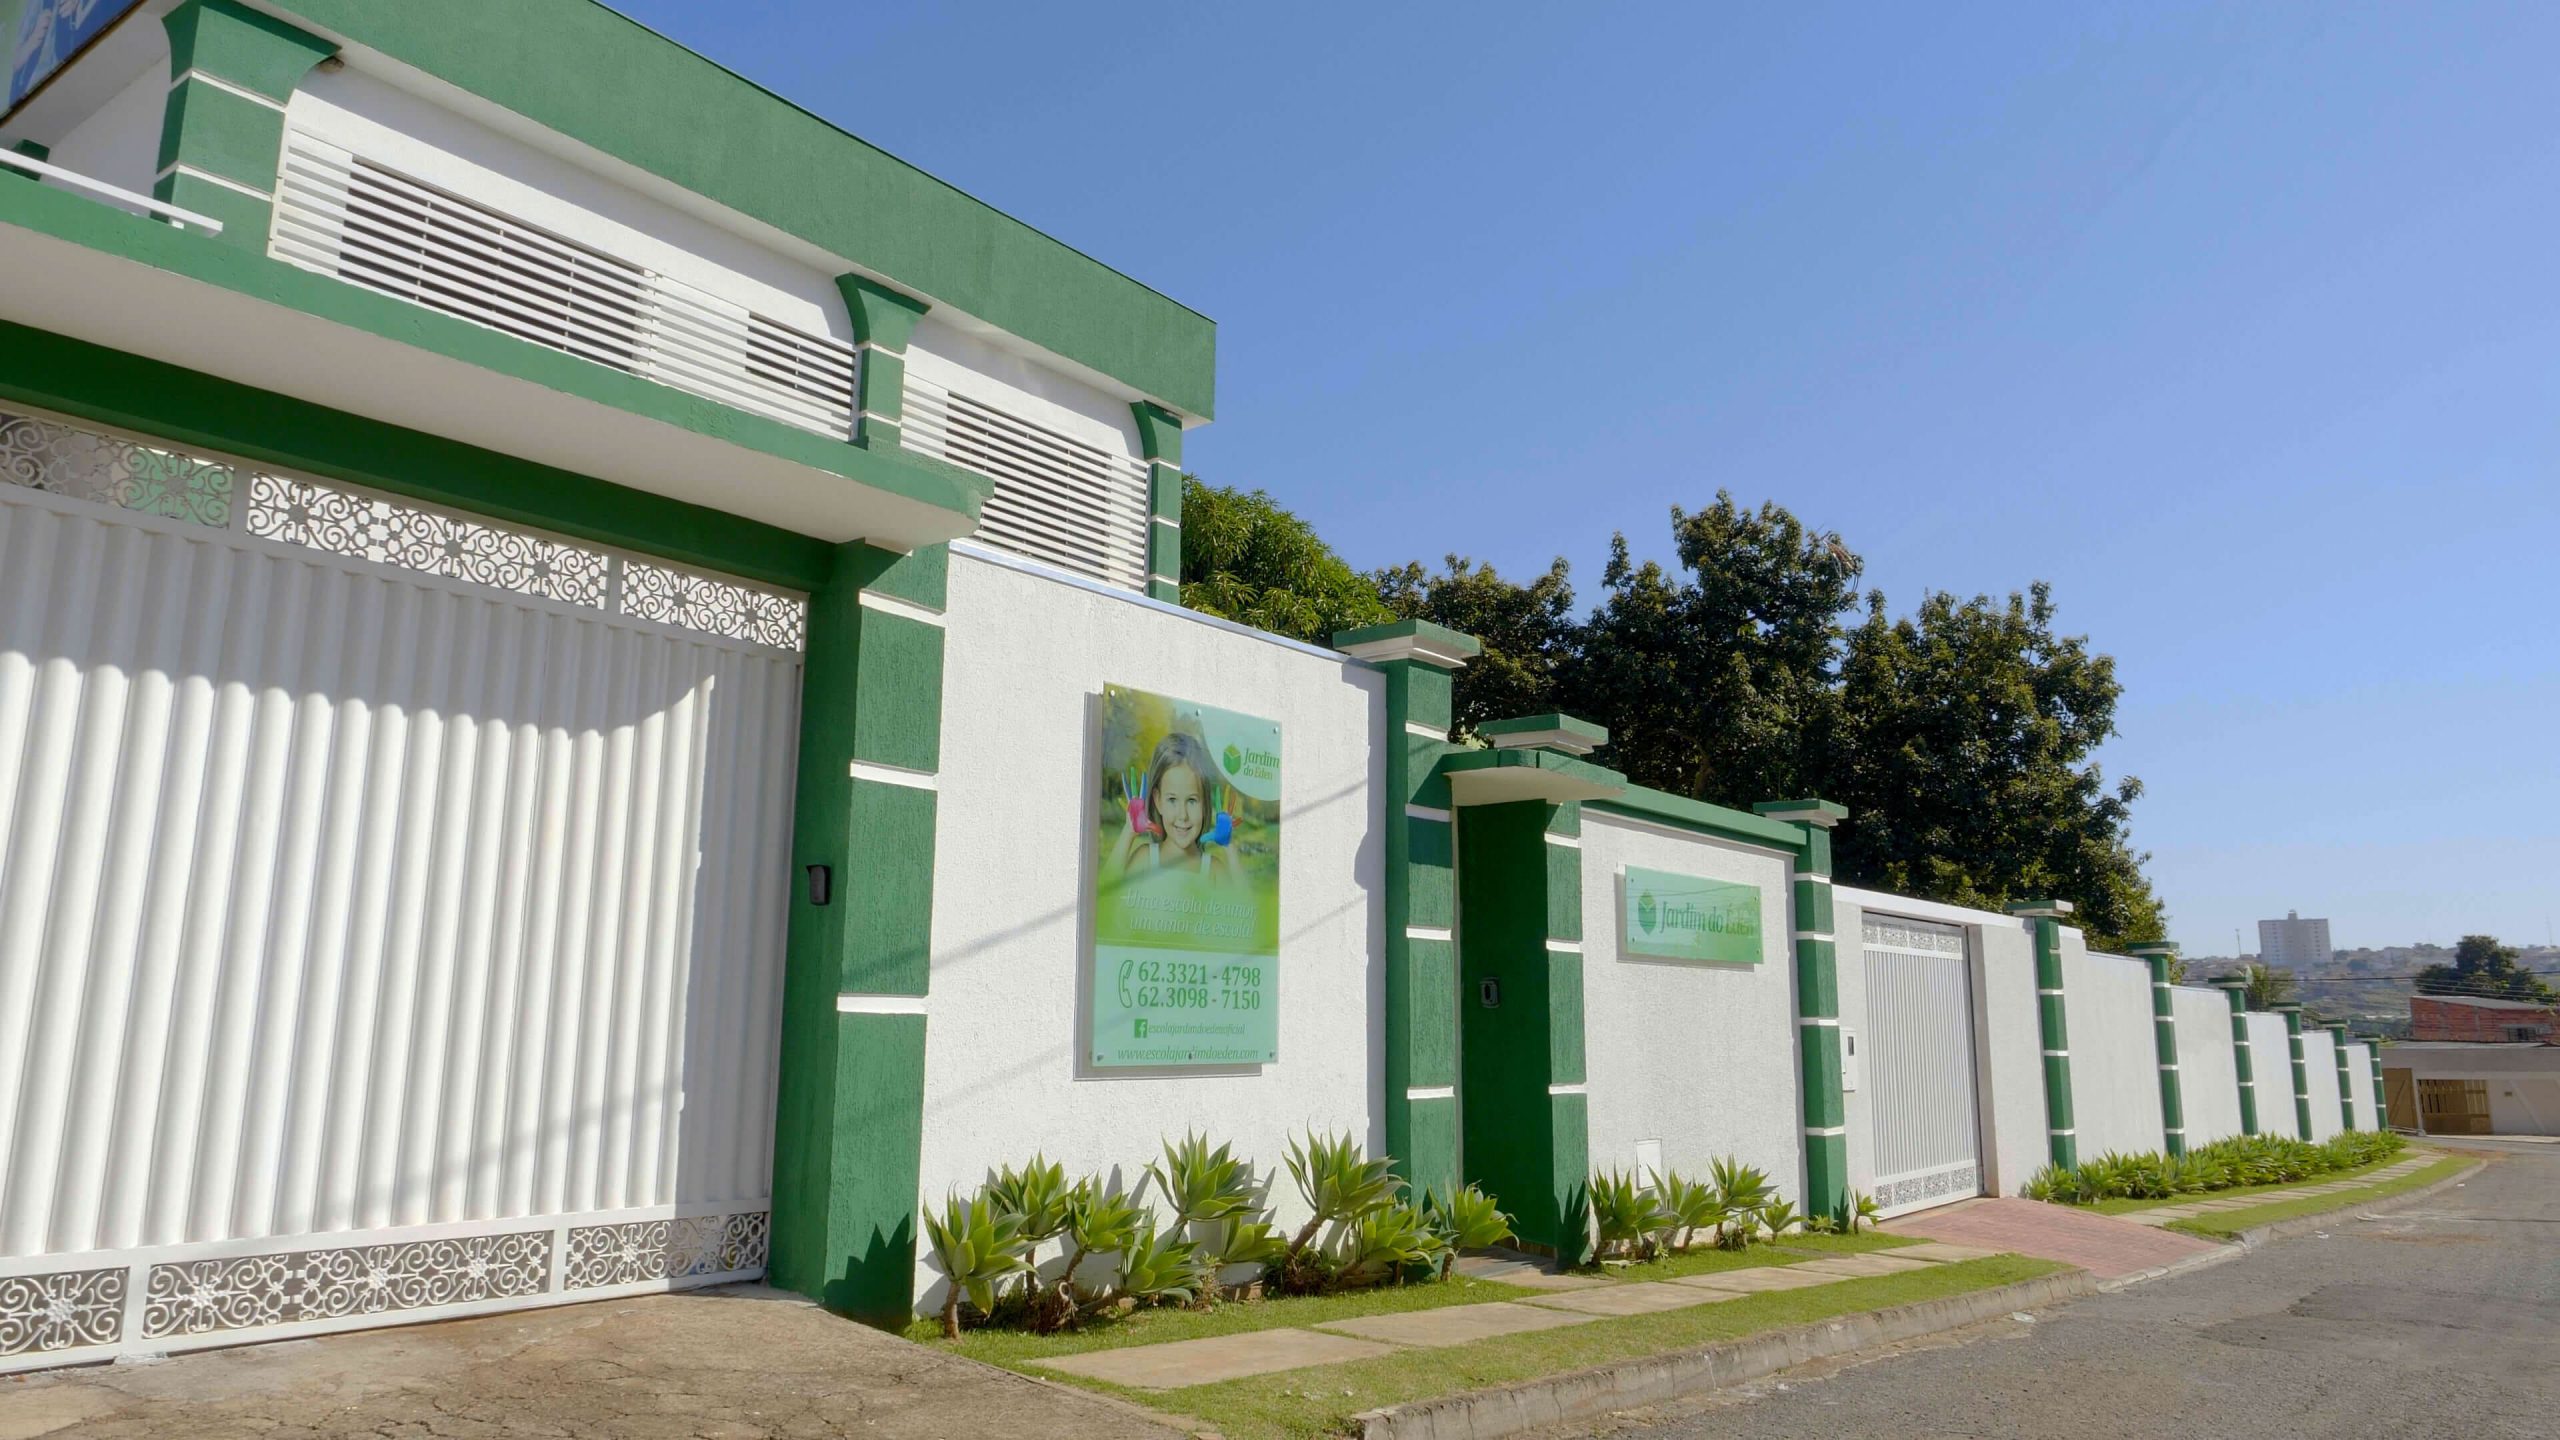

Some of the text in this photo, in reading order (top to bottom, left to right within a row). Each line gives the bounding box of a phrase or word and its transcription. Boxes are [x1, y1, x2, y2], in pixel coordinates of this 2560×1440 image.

[1243, 747, 1280, 768] Jardim
[1243, 764, 1254, 777] do
[1659, 901, 1706, 934] Jardim
[1708, 906, 1724, 934] do
[1138, 961, 1208, 985] 62.3321
[1221, 966, 1261, 988] 4798
[1137, 987, 1208, 1009] 62.3098
[1222, 990, 1260, 1010] 7150
